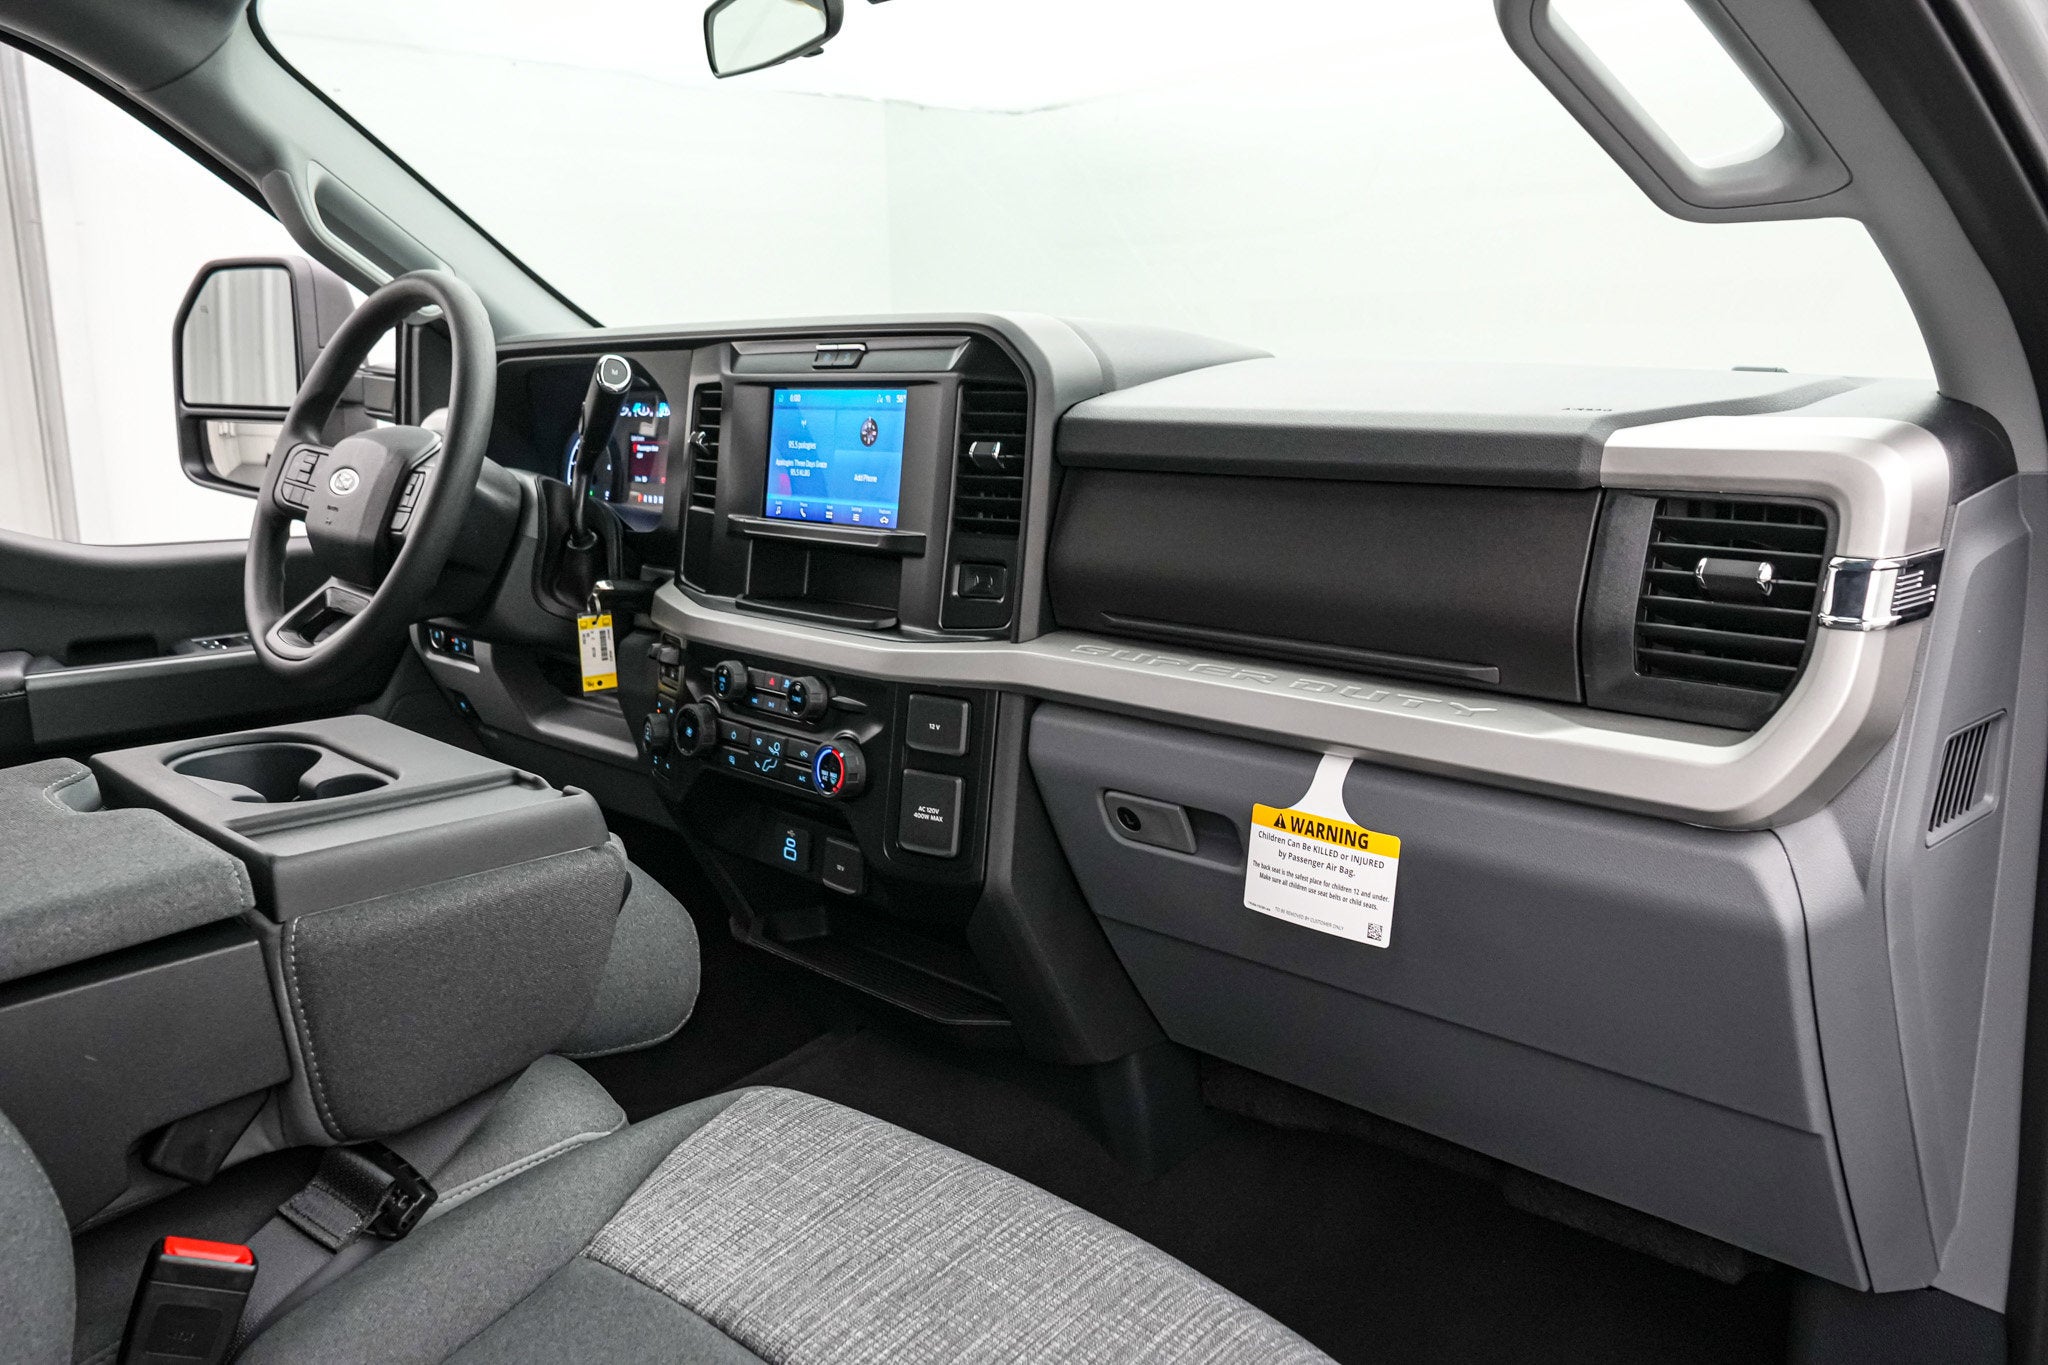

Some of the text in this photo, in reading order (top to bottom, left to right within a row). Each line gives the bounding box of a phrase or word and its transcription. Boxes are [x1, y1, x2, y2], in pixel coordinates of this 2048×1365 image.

[1070, 644, 1498, 717] SUPER DUTY
[1258, 831, 1286, 844] Children
[1287, 839, 1301, 848] Can
[1302, 842, 1312, 851] Be
[1313, 845, 1339, 858] KILLED
[1351, 855, 1385, 869] INJURED
[1290, 816, 1369, 849] WARNING
[1278, 849, 1356, 878] by Passenger Air Bag.
[1259, 872, 1271, 881] Make
[1272, 877, 1282, 885] sure
[1288, 881, 1308, 892] children
[1308, 887, 1317, 895] use
[1317, 890, 1328, 898] seat
[1329, 892, 1341, 902] belts
[1349, 897, 1362, 907] child
[1260, 863, 1271, 871] back
[1286, 870, 1294, 878] the
[1295, 873, 1309, 882] safest
[1309, 877, 1322, 886] place
[1323, 879, 1331, 888] for
[1331, 883, 1352, 893] children
[1353, 888, 1360, 896] 12
[1360, 890, 1371, 899] and
[1372, 893, 1390, 903] under.
